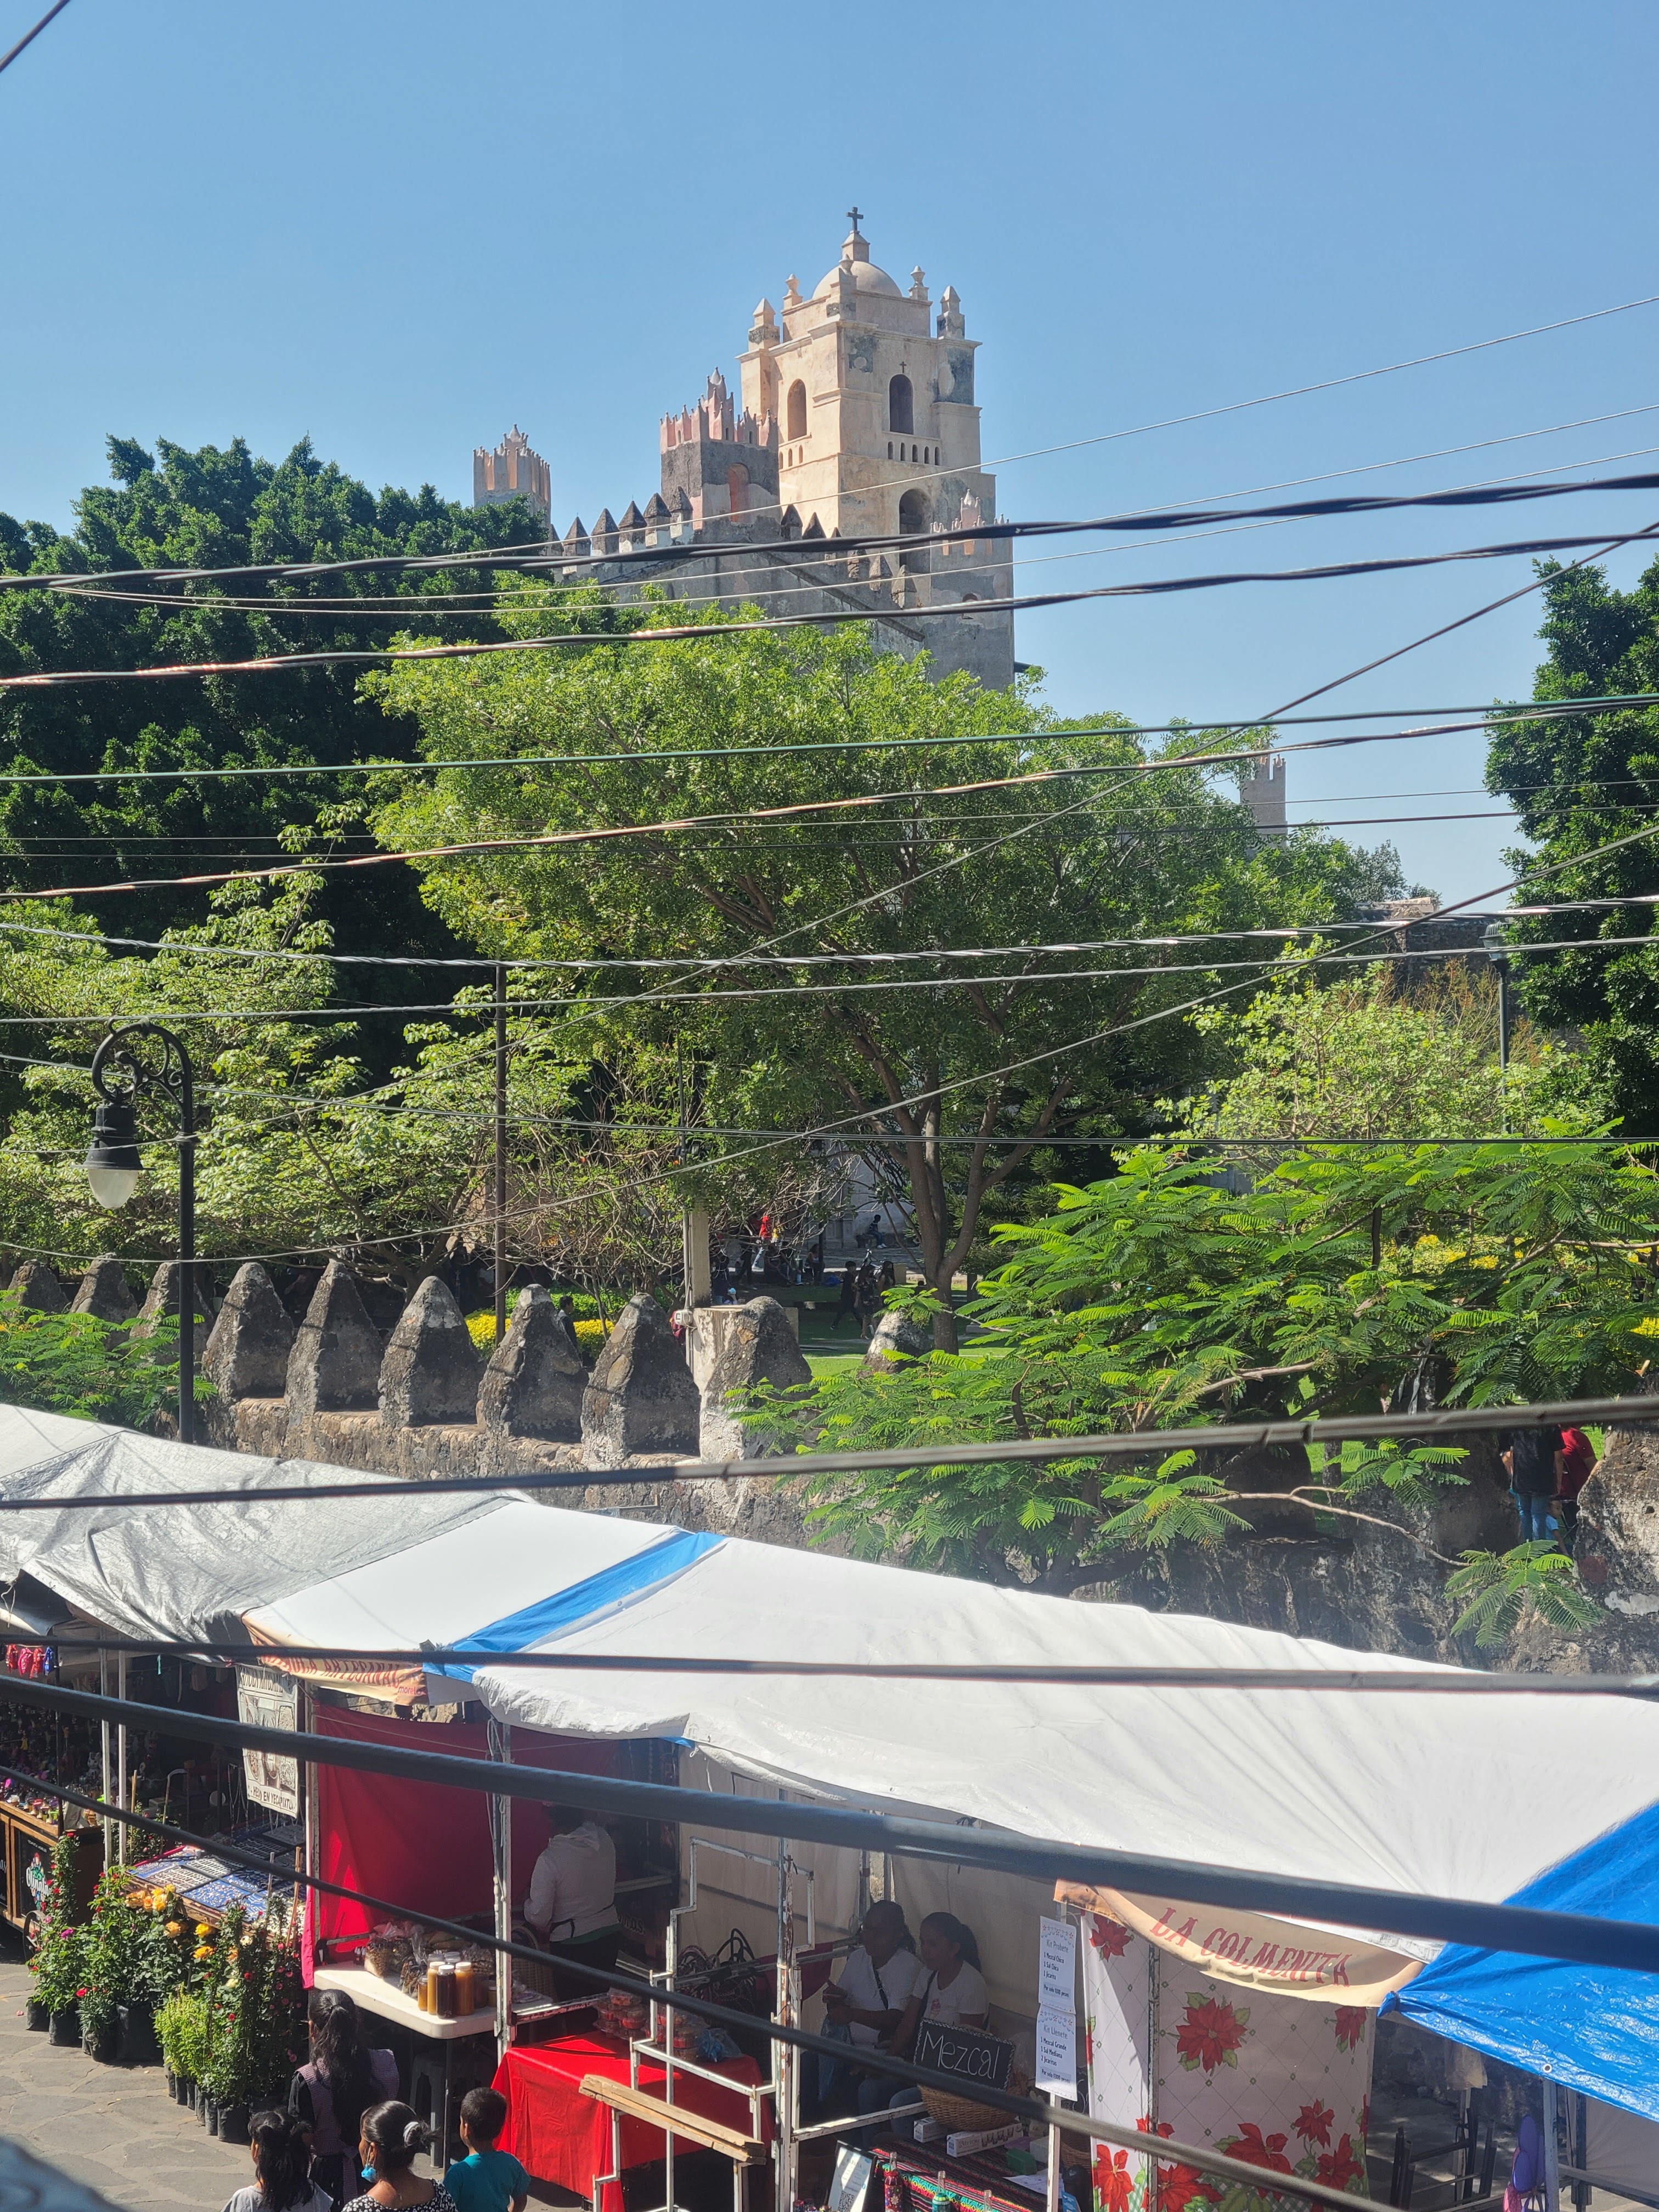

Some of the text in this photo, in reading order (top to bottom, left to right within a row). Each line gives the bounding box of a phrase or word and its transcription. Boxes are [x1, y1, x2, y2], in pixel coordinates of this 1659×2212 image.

[320, 1658, 399, 1689] ARTESANAL
[398, 1686, 424, 1696] morelo
[263, 1791, 270, 1803] EN
[1150, 1907, 1352, 1987] LA COLMENITA
[1047, 1953, 1056, 1961] Mezcal
[1051, 2026, 1068, 2039] Llenete
[1043, 2038, 1054, 2047] Mezcal
[1054, 2041, 1066, 2051] Grande
[921, 2030, 1000, 2079] Mezcal
[1049, 2048, 1062, 2058] Mediana
